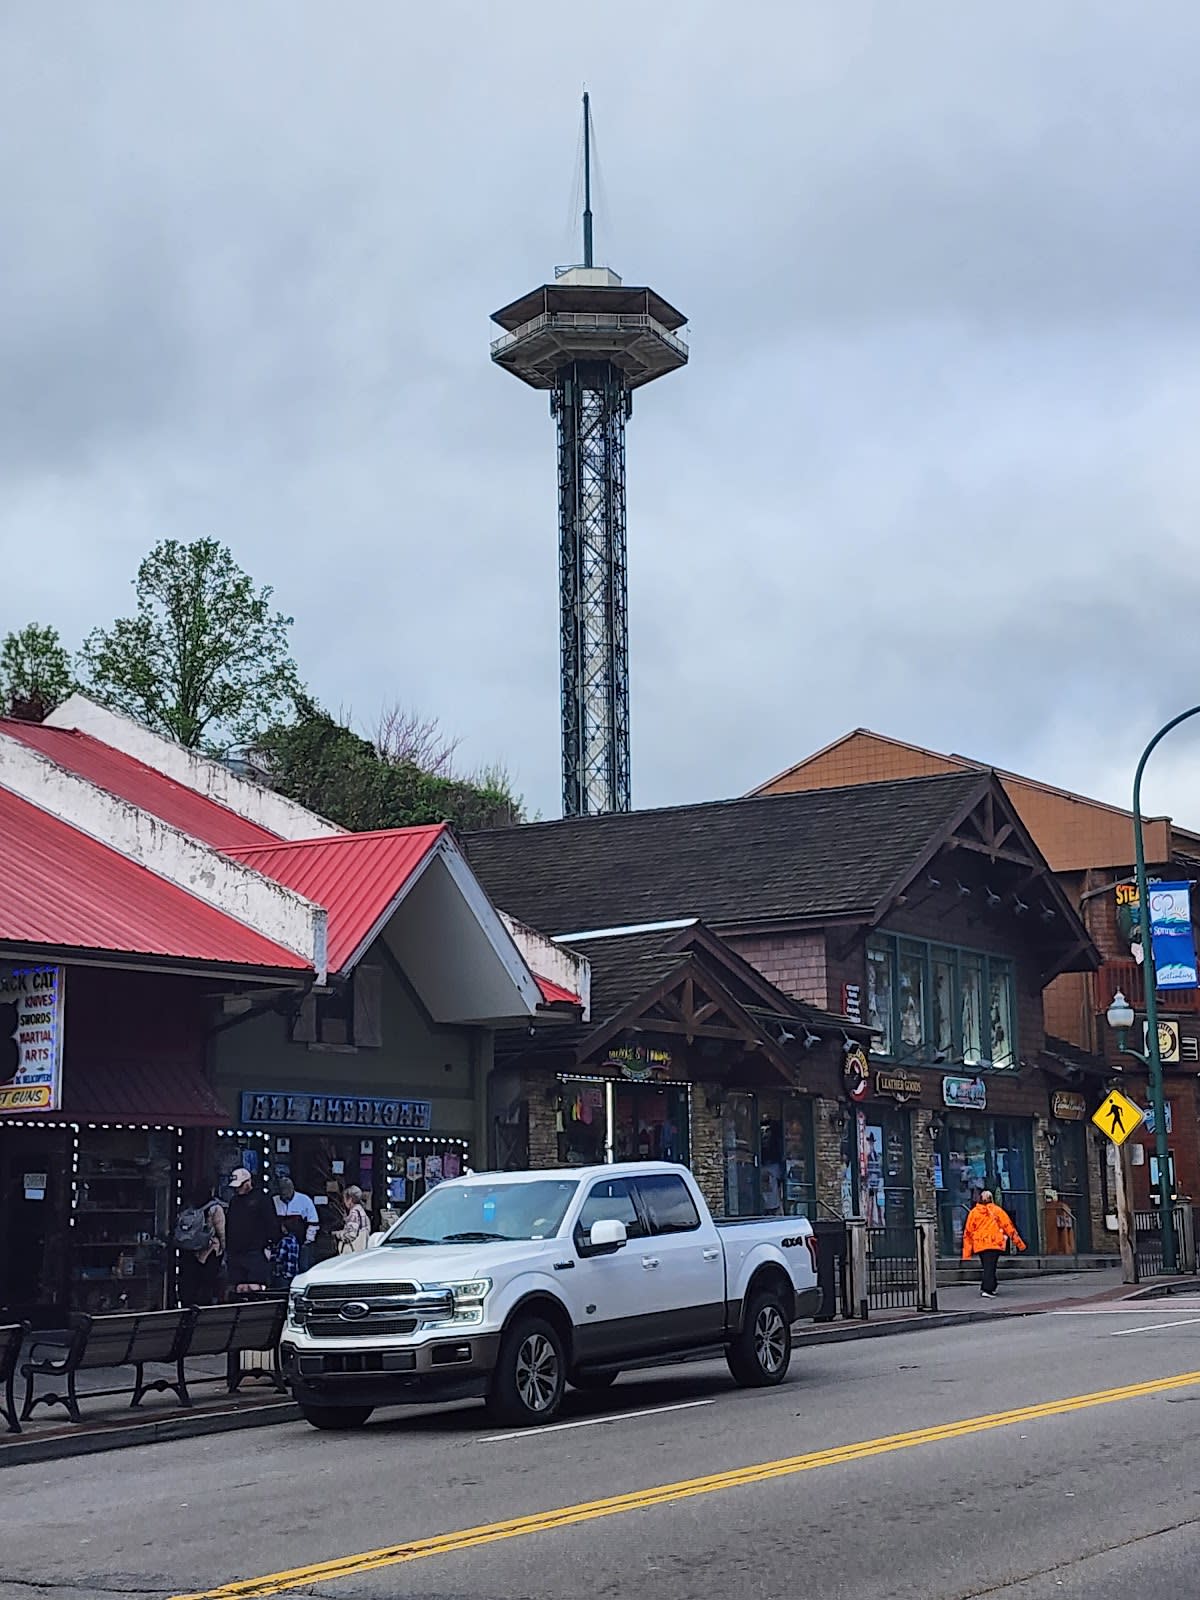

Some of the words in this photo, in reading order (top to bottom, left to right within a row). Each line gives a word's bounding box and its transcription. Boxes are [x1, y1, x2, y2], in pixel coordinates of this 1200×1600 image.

[32, 971, 55, 989] CAT
[25, 994, 54, 1008] KNIVES
[20, 1012, 51, 1027] SWORDS
[19, 1030, 52, 1044] MARTIAL
[25, 1048, 49, 1061] ARTS
[881, 1078, 904, 1091] LEATHER
[905, 1080, 921, 1092] GOODS
[12, 1090, 42, 1104] GUNS
[252, 1096, 297, 1120] ALL
[310, 1098, 425, 1126] AMERICAN
